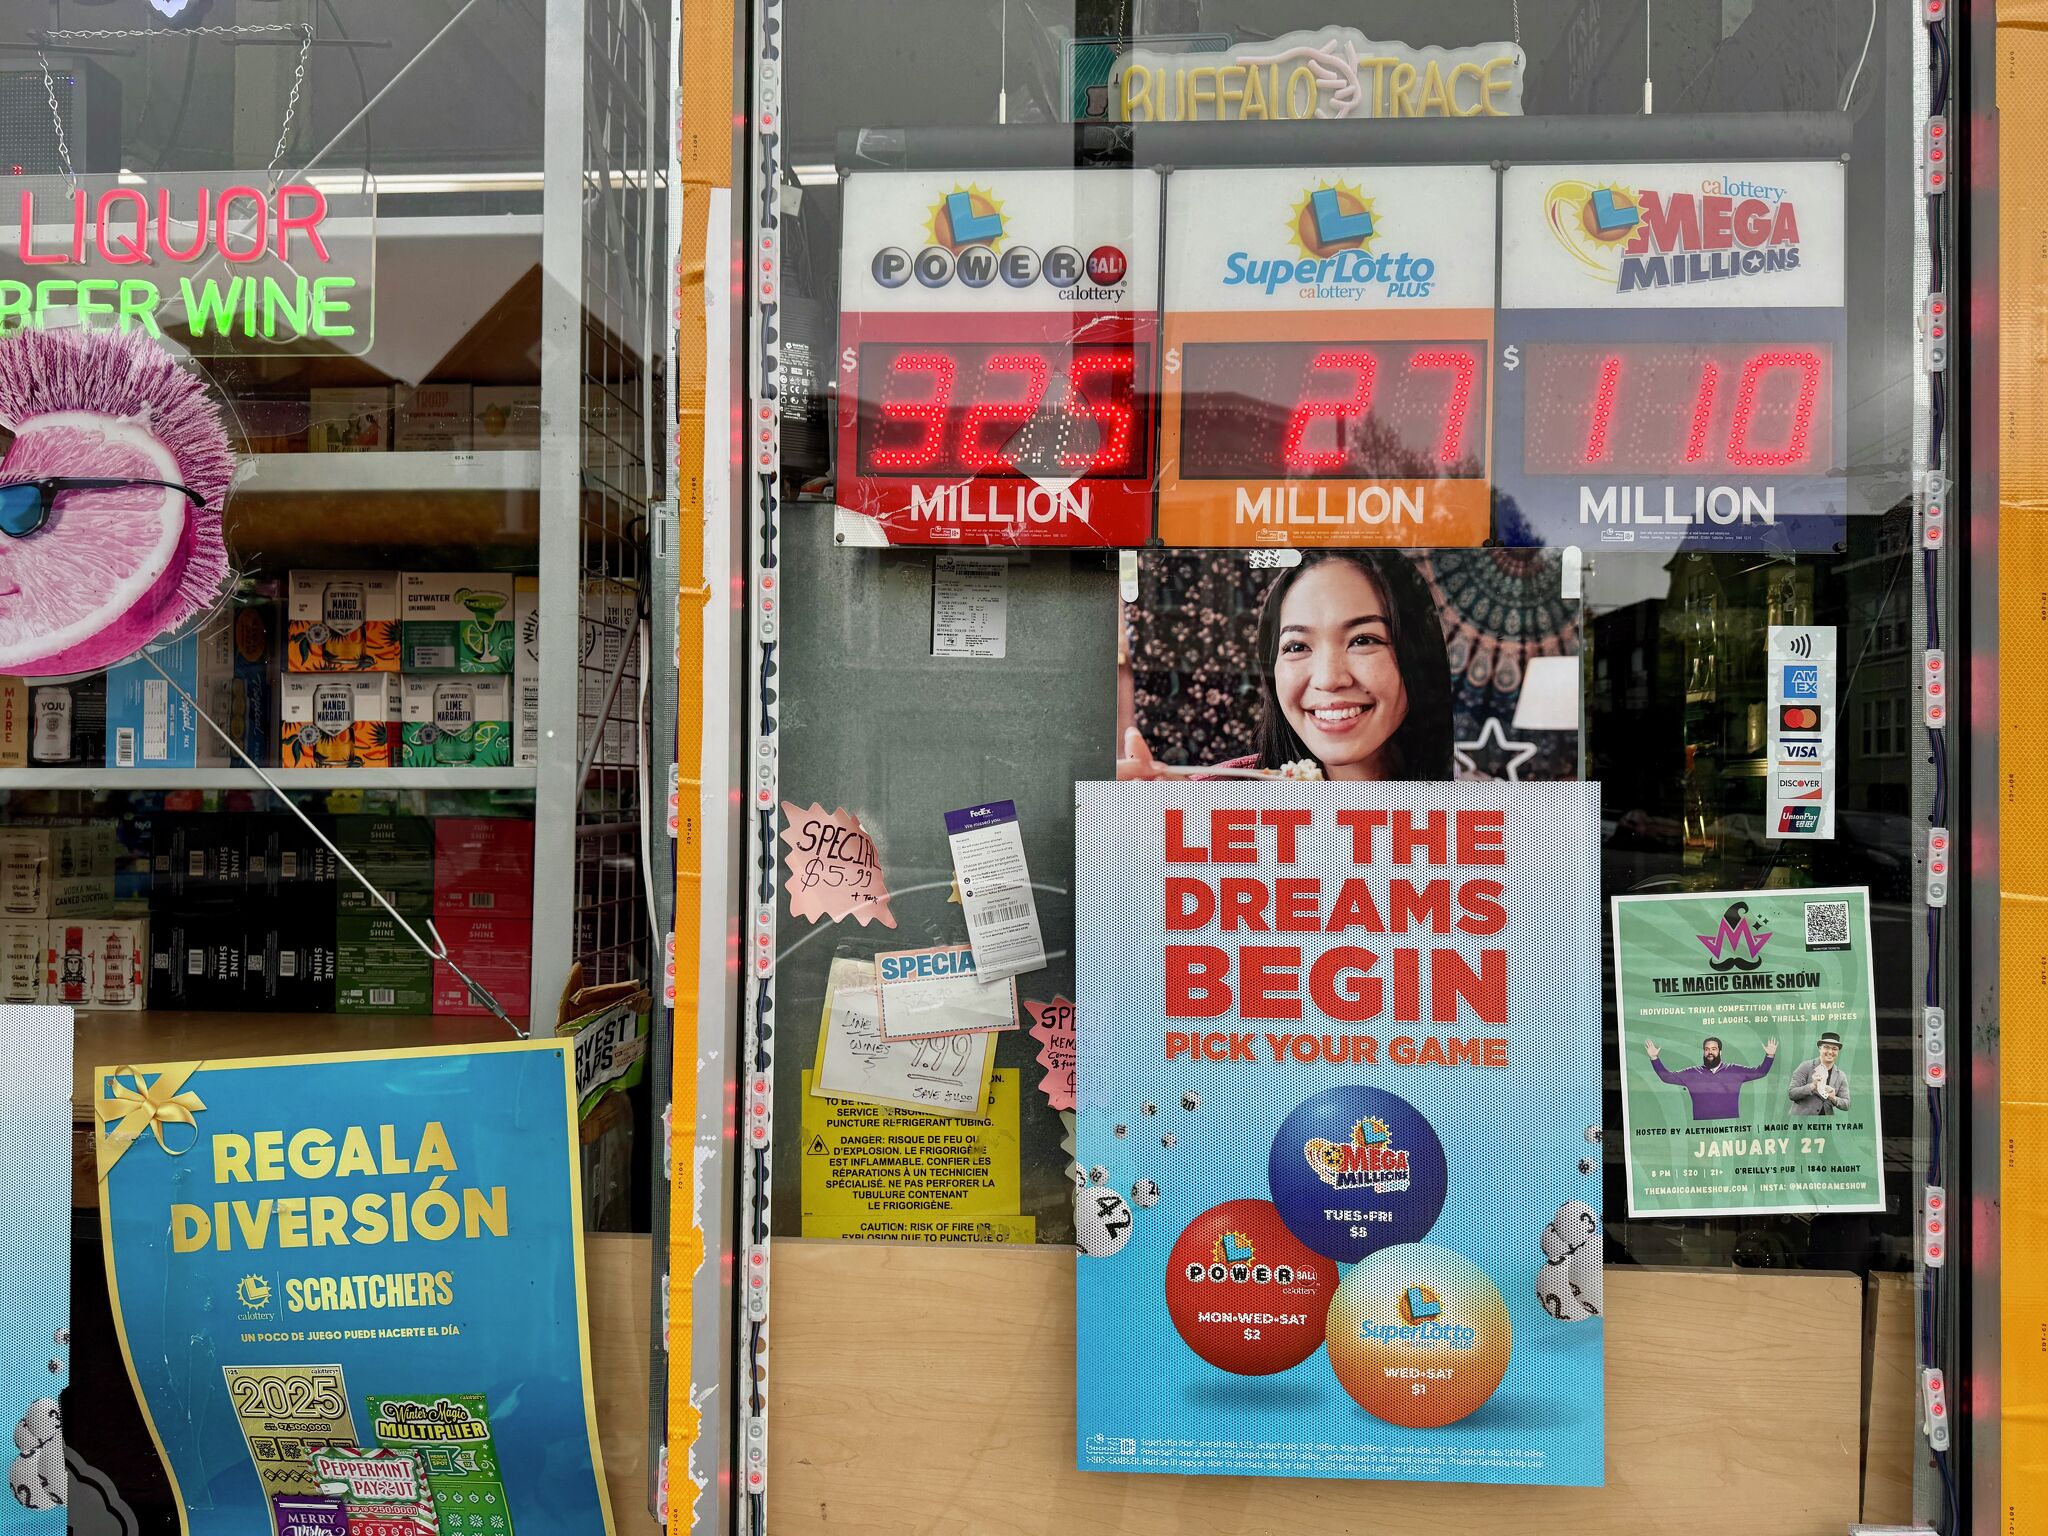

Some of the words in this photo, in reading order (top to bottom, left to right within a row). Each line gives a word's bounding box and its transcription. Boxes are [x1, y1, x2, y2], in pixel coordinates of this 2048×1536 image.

[1121, 62, 1317, 121] BUFFALO
[1359, 57, 1512, 118] TRACE
[1701, 176, 1787, 203] calottery
[19, 185, 330, 265] LIQUOR
[1624, 189, 1800, 255] MEGA
[1222, 249, 1434, 295] SuperLotto
[1618, 248, 1800, 292] MILLIONS
[1059, 286, 1125, 303] calottery
[1300, 284, 1365, 301] calottery
[1387, 282, 1430, 298] PLUS
[179, 276, 356, 337] WINE
[1284, 353, 1476, 466] 27
[1586, 353, 1822, 465] 110
[910, 485, 1090, 523] MILLION
[1236, 487, 1424, 524] MILLION
[1580, 486, 1775, 525] MILLION
[332, 600, 357, 610] MANGO
[327, 611, 363, 621] MARGARITA
[41, 702, 65, 711] YOJU
[322, 701, 346, 710] MANGO
[446, 701, 462, 710] LIME
[4, 687, 15, 743] MADRE
[317, 711, 350, 721] MARGARITA
[437, 711, 471, 721] MARGARITA
[1784, 746, 1817, 757] VISA
[1780, 779, 1820, 787] DISCOVER
[970, 808, 992, 818] FedEx
[1782, 812, 1817, 825] UnionPay
[973, 819, 991, 827] missed
[1164, 809, 1312, 863] LET
[1336, 809, 1505, 865] THE
[796, 821, 881, 871] SPECIAL
[801, 857, 872, 892] $5.99
[1164, 877, 1507, 936] DREAMS
[469, 930, 494, 938] SHINE
[218, 945, 228, 980] SHINE
[229, 948, 239, 978] JUNE
[1164, 945, 1507, 1024] BEGIN
[1652, 977, 1679, 993] THE
[1682, 974, 1729, 993] MAGIC
[1732, 973, 1773, 990] GAME
[1776, 972, 1821, 989] SHOW
[1640, 1007, 1686, 1016] INDIVIDUAL
[1689, 1006, 1715, 1014] TRIVIA
[1718, 1004, 1773, 1013] COMPETITION
[1775, 1003, 1796, 1011] WITH
[1798, 1002, 1817, 1010] LIVE
[1820, 1001, 1845, 1010] MAGIC
[1165, 1032, 1257, 1061] PICK
[1264, 1033, 1379, 1064] YOUR
[1388, 1036, 1509, 1067] GAME
[912, 1087, 939, 1100] SAVE
[826, 1119, 880, 1127] PUNCTURE
[882, 1118, 951, 1127] REFRIGERANT
[1635, 1127, 1667, 1136] HOSTED
[1670, 1127, 1681, 1135] BY
[1685, 1124, 1752, 1135] ALETHIOMETRIST
[1764, 1123, 1788, 1132] MAGIC
[1792, 1123, 1804, 1131] BY
[1807, 1122, 1832, 1131] KEITH
[1835, 1122, 1864, 1131] TYRAN
[840, 1136, 885, 1144] DANGER:
[888, 1136, 926, 1145] RISQUE
[927, 1136, 941, 1144] DE
[943, 1136, 963, 1144] FEU
[1694, 1138, 1789, 1158] JANUARY
[1801, 1137, 1826, 1154] 27
[212, 1121, 458, 1184] REGALA
[1337, 1144, 1408, 1172] MEGA
[832, 1167, 901, 1177] RÉPARATIONS
[903, 1167, 911, 1177] À
[913, 1169, 927, 1177] UN
[929, 1168, 989, 1177] TECHNICIEN
[1683, 1169, 1698, 1177] $20
[1735, 1166, 1777, 1175] O'REILLY'S
[1781, 1165, 1795, 1174] PUB
[1807, 1165, 1827, 1173] 1840
[1830, 1164, 1861, 1173] HAIGHT
[852, 1190, 906, 1199] TUBULURE
[908, 1190, 969, 1199] CONTENANT
[1644, 1184, 1748, 1195] THEMAGICGAMESHOW.COM
[1760, 1183, 1786, 1192] INSTA:
[1789, 1182, 1867, 1191] @MAGICGAMESHOW
[868, 1202, 881, 1210] LE
[883, 1200, 953, 1210] FRIGORIGÈNE.
[171, 1176, 508, 1253] DIVERSIÓN
[860, 1222, 908, 1231] CAUTION:
[910, 1222, 933, 1231] RISK
[935, 1222, 949, 1231] OF
[952, 1222, 973, 1231] FIRE
[285, 1271, 454, 1312] SCRATCHERS
[238, 1310, 275, 1321] calottery
[241, 1333, 255, 1343] UN
[257, 1332, 289, 1343] POCO
[291, 1331, 305, 1341] DE
[306, 1330, 342, 1340] JUEGO
[344, 1329, 377, 1340] PUEDE
[378, 1327, 426, 1338] HACERTE
[427, 1326, 439, 1337] EL
[440, 1324, 460, 1336] DÍA
[1243, 1328, 1261, 1340] $2
[1360, 1319, 1475, 1344] SuperLotto
[232, 1375, 346, 1419] 2025
[1411, 1383, 1426, 1396] $1
[384, 1402, 428, 1423] Winter
[425, 1400, 469, 1423] Magic
[278, 1422, 332, 1432] $7,500,000!
[378, 1420, 486, 1440] MULTIPLIER
[319, 1459, 411, 1478] PEPPERMINT
[354, 1480, 412, 1497] PAYOUT
[288, 1513, 336, 1524] MERRY
